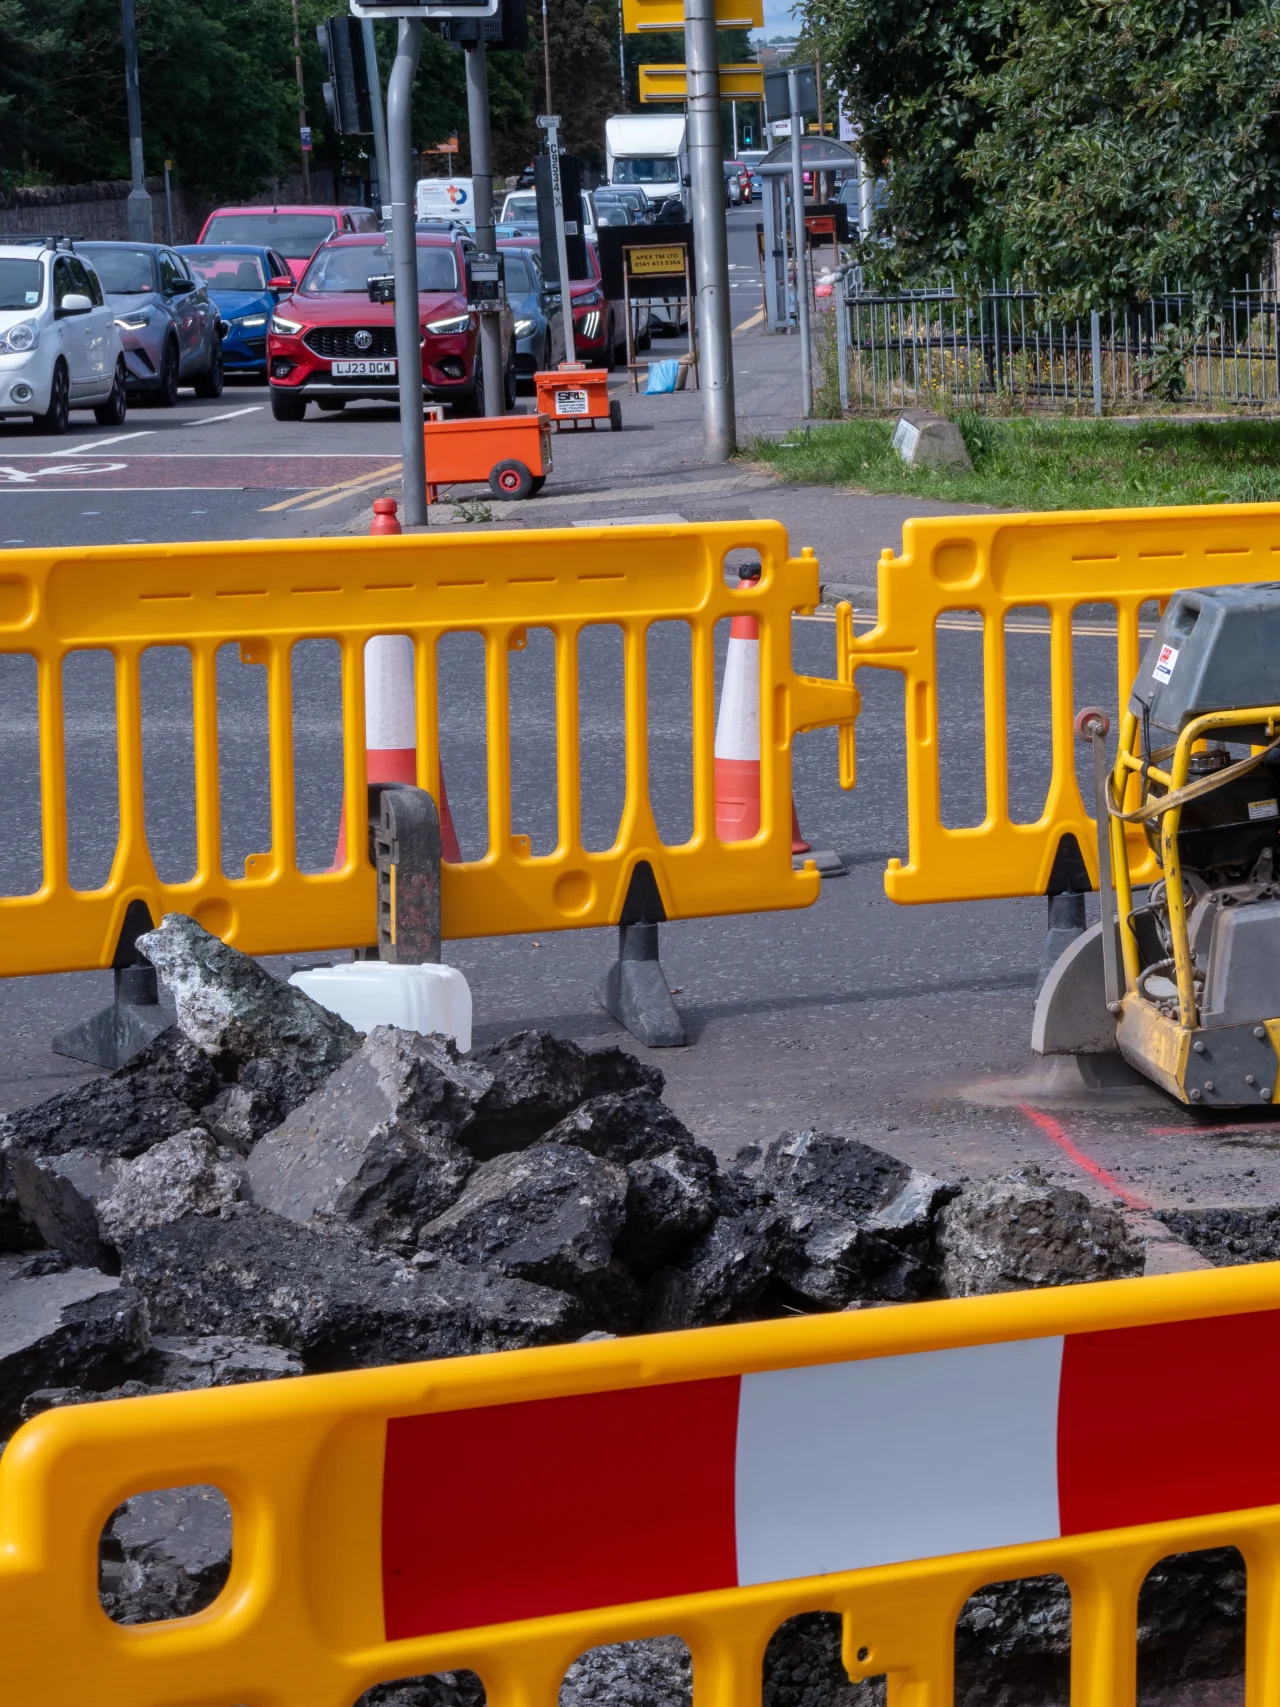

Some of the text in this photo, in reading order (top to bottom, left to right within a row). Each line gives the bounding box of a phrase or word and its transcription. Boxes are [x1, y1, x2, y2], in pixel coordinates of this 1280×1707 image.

[550, 144, 560, 192] C9534
[336, 362, 391, 374] LJ23 DGW
[558, 391, 585, 400] SRL
